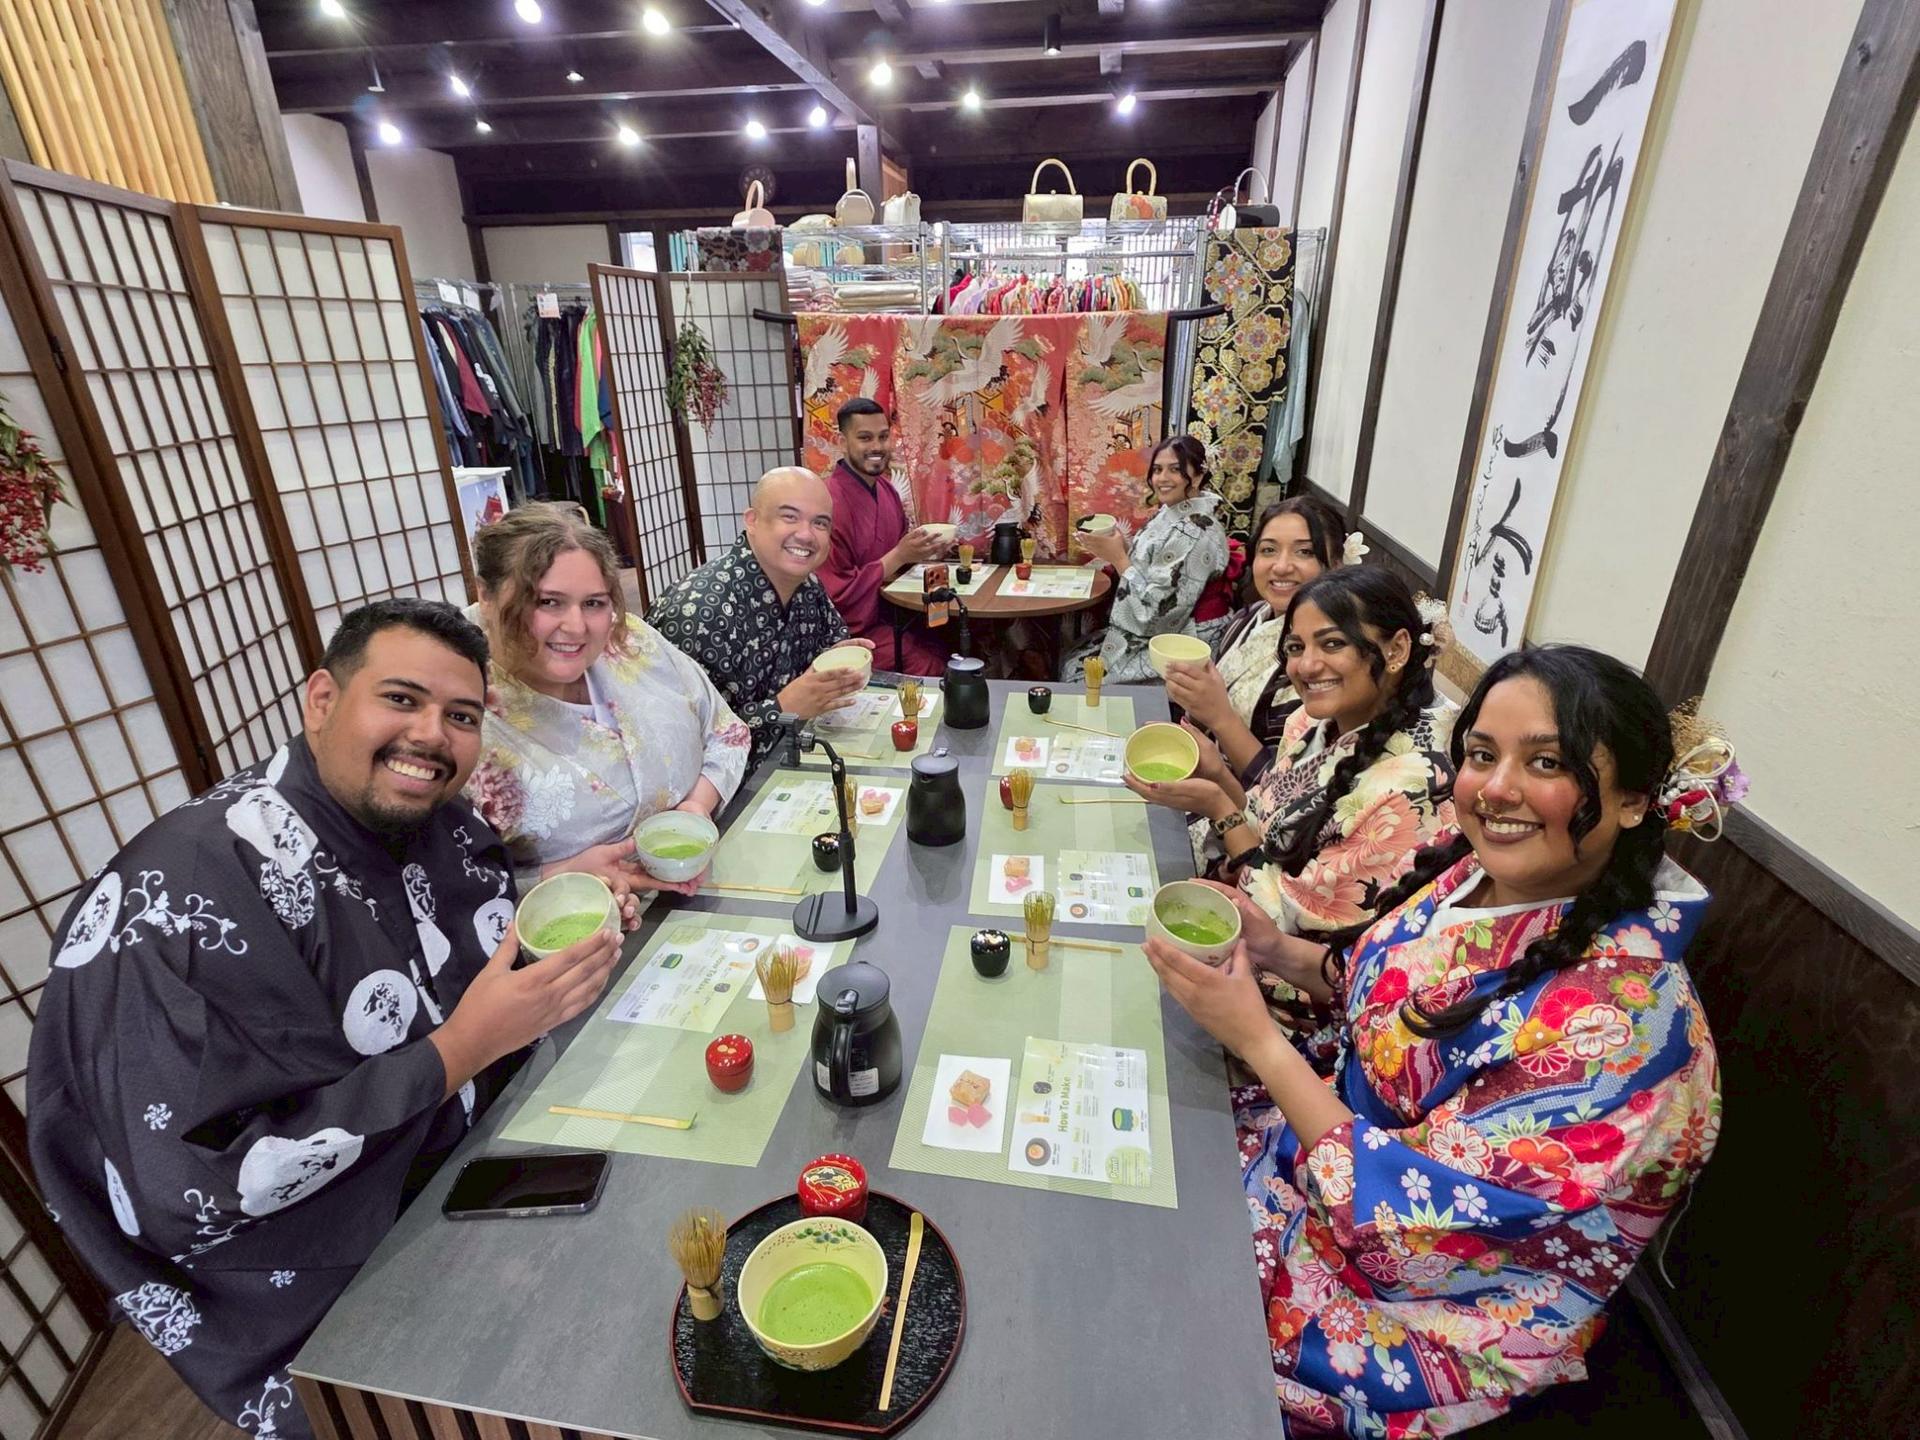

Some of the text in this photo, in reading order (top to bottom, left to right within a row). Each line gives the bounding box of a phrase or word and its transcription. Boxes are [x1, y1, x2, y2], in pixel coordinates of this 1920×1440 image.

[1057, 1076, 1072, 1133] How To Make
